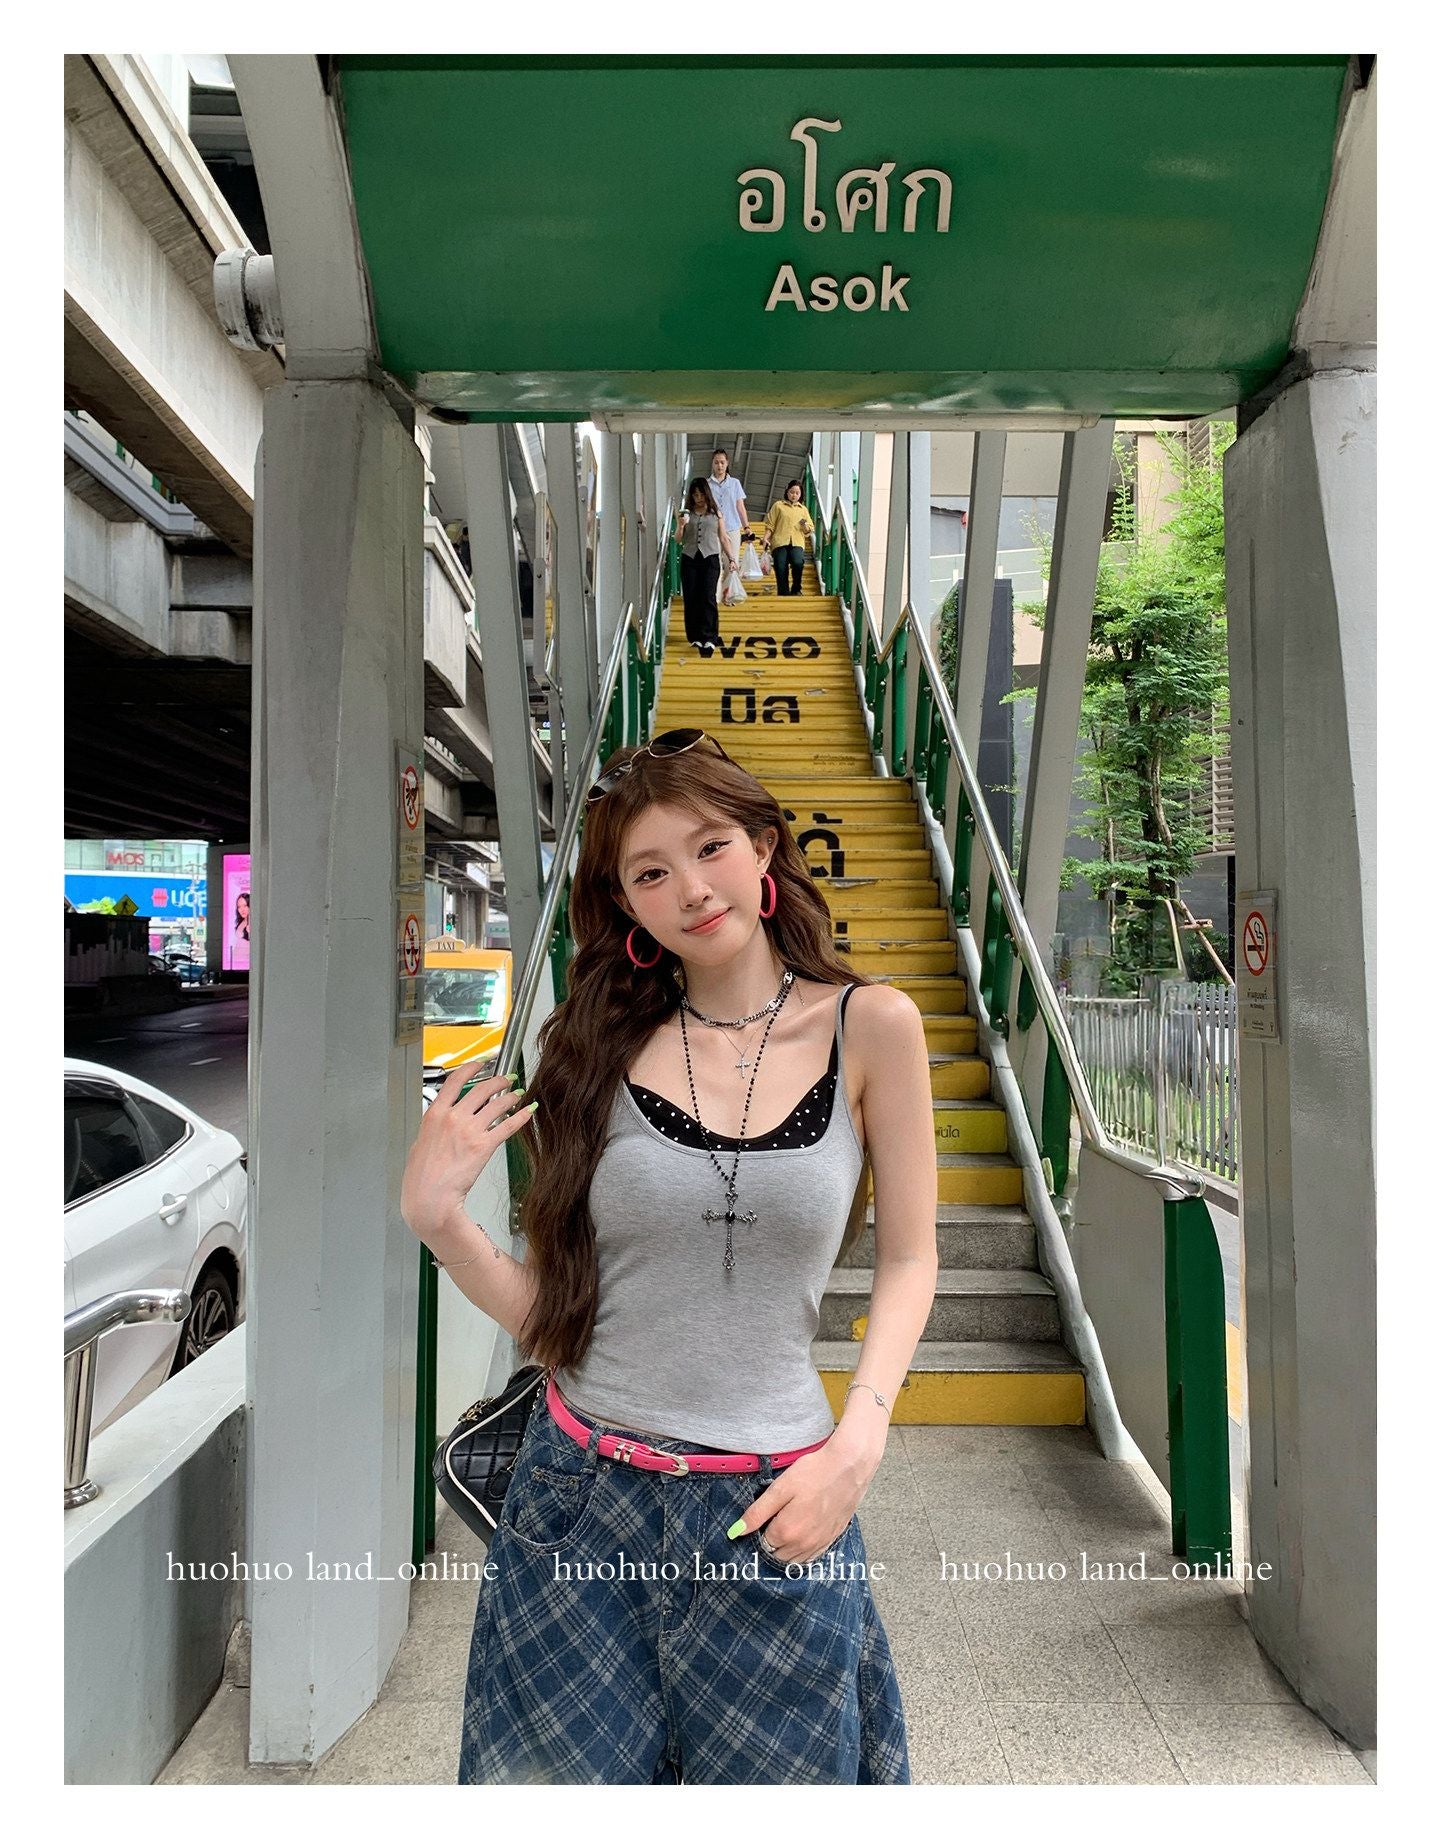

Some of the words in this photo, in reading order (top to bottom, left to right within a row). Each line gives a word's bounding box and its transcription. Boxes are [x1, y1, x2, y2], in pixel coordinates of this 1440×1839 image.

[736, 117, 953, 233] อโศก
[764, 264, 911, 312] Asok
[436, 941, 455, 950] TAXI
